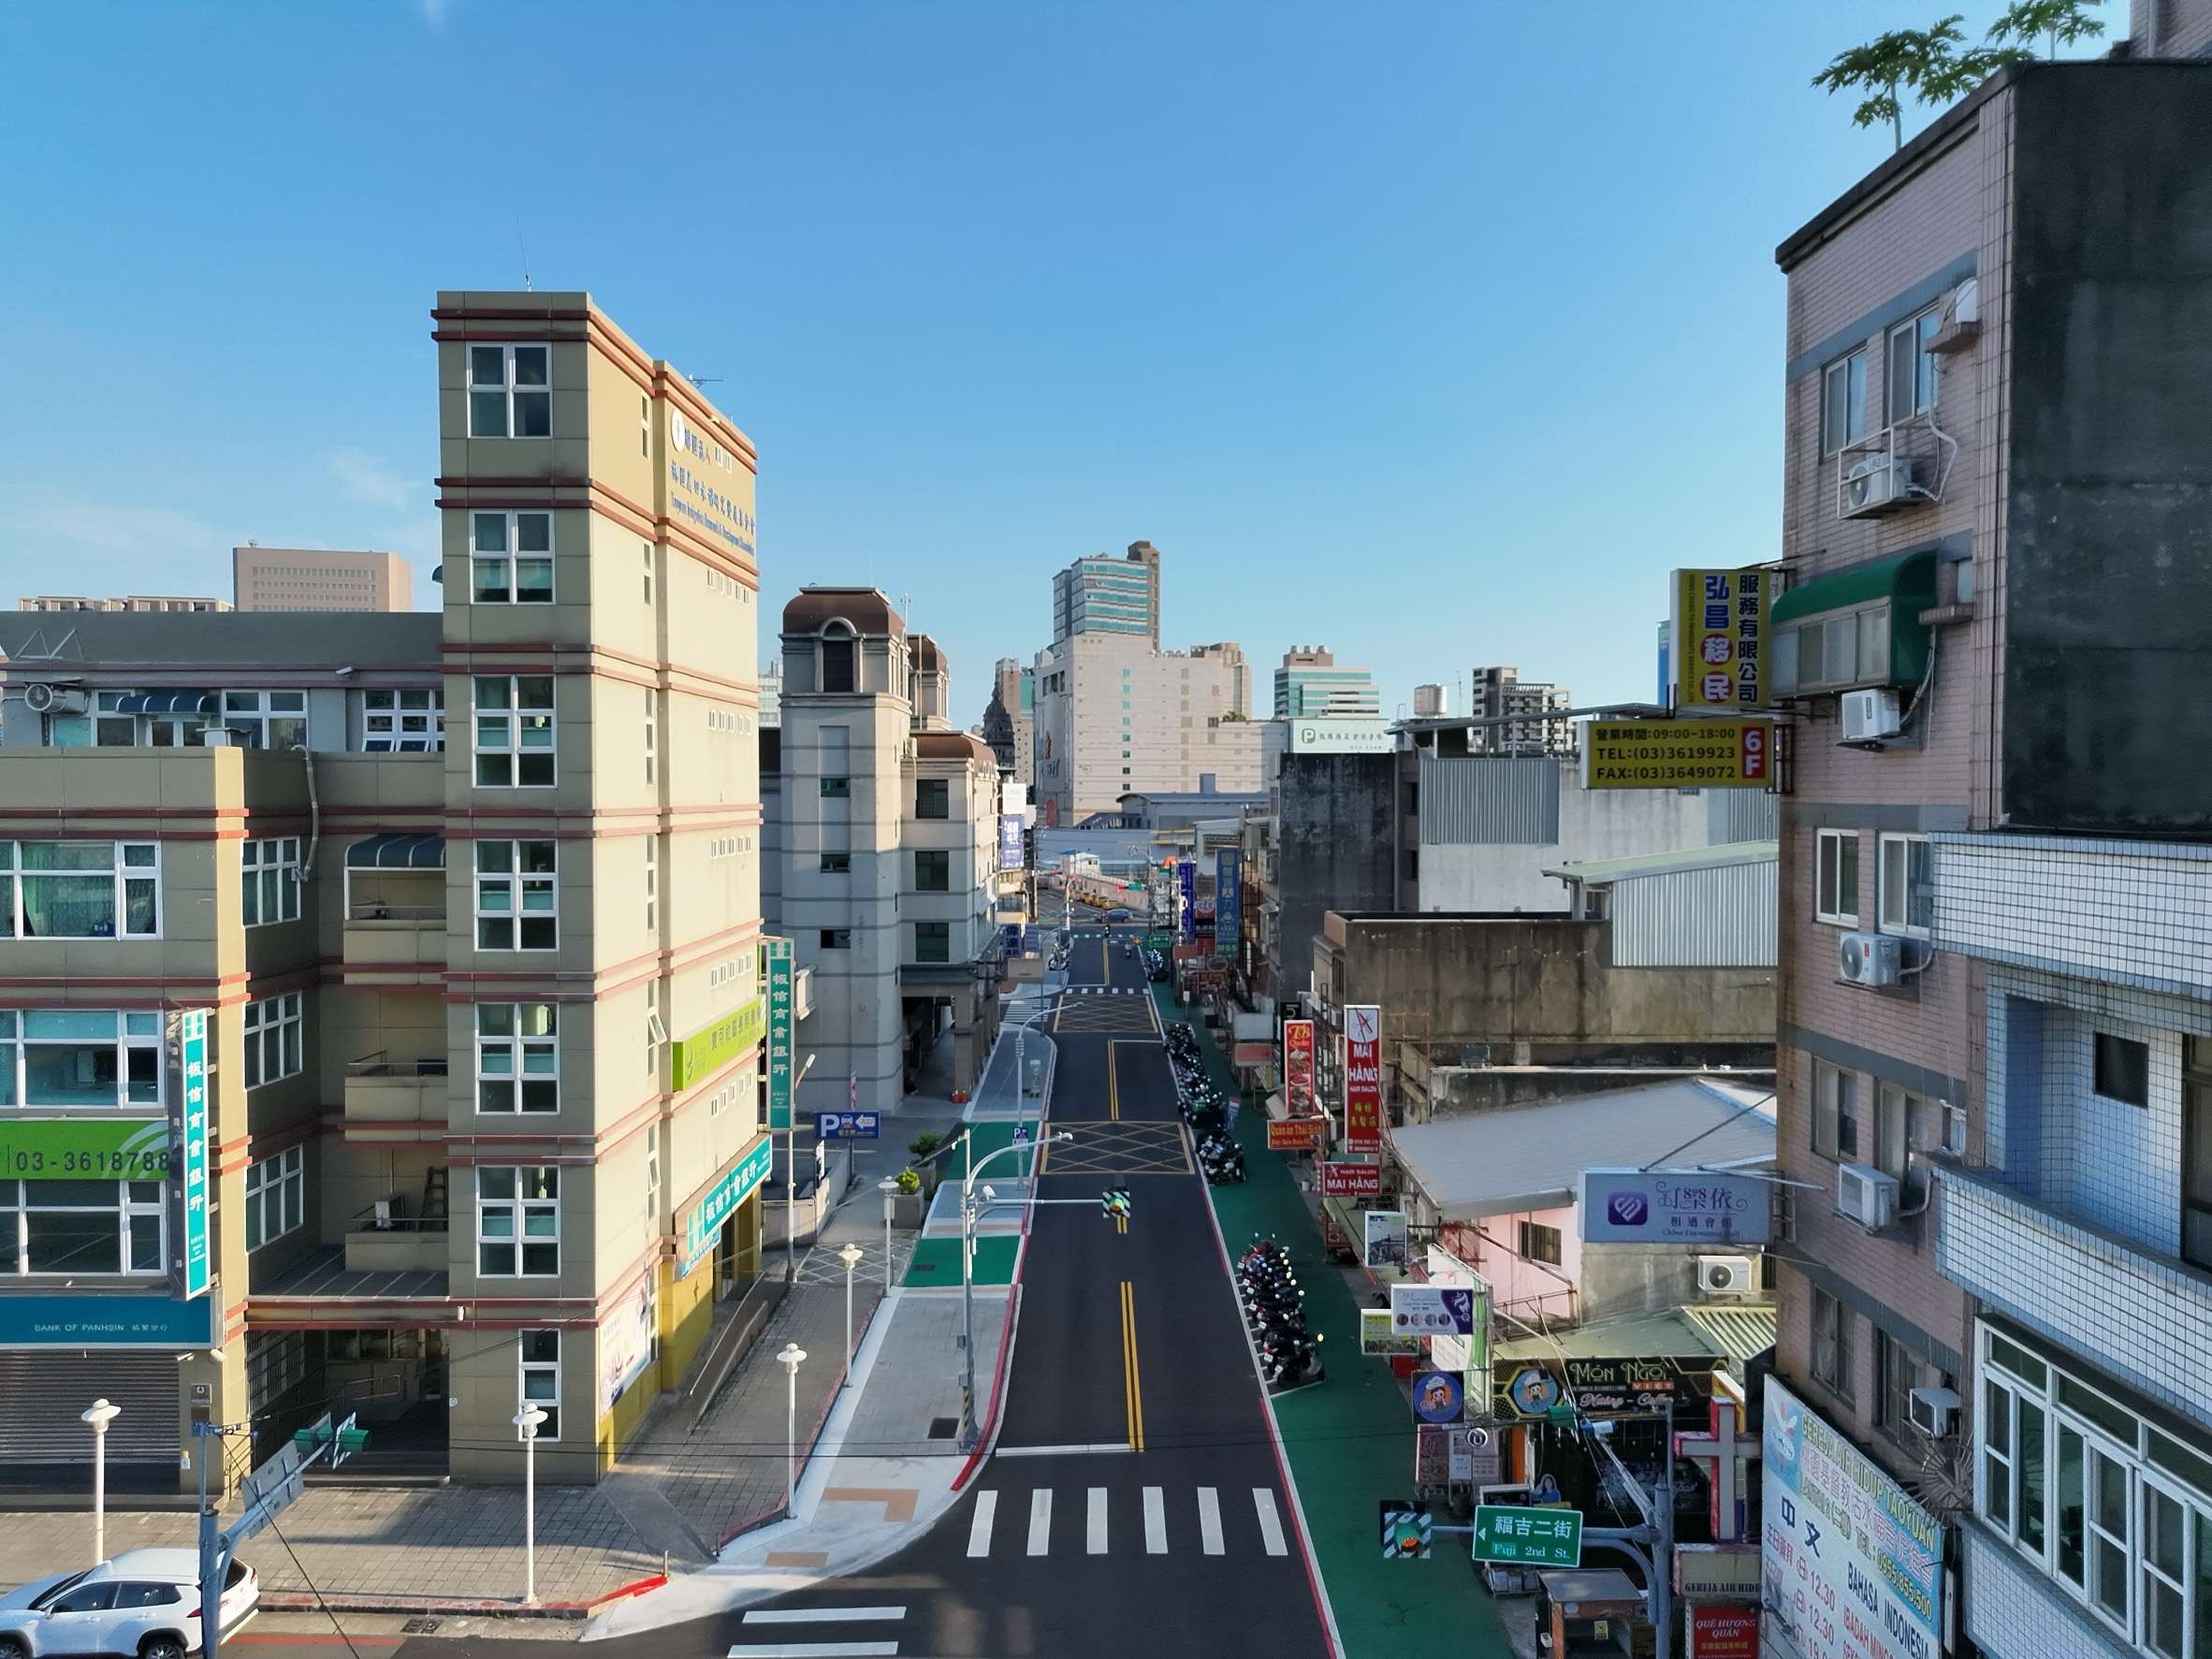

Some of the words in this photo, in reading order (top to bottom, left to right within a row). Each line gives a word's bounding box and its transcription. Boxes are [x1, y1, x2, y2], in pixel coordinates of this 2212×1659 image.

[1704, 575, 1730, 701] 弘昌移民
[1739, 575, 1759, 703] 服務有限公司
[1353, 1043, 1373, 1058] MAI
[1348, 1063, 1378, 1082] HÀNG
[821, 1114, 839, 1138] P
[16, 1152, 169, 1171] 03-3618788
[1327, 1179, 1346, 1189] MAI
[1348, 1175, 1378, 1189] HÀNG
[1802, 1413, 1835, 1462] GEREJA
[1855, 1455, 1885, 1503] HIDUP
[1885, 1483, 1935, 1554] TAOYUAN
[1494, 1516, 1572, 1539] 福吉二街
[1782, 1497, 1822, 1558] 中文
[1493, 1543, 1517, 1557] Fuji
[1524, 1546, 1546, 1557] 2nd
[1554, 1548, 1571, 1559] St.
[1684, 1582, 1717, 1593] GEREJA
[1721, 1582, 1737, 1592] AIR
[1848, 1561, 1879, 1618] BAHASA
[1885, 1598, 1928, 1659] INDONESIA
